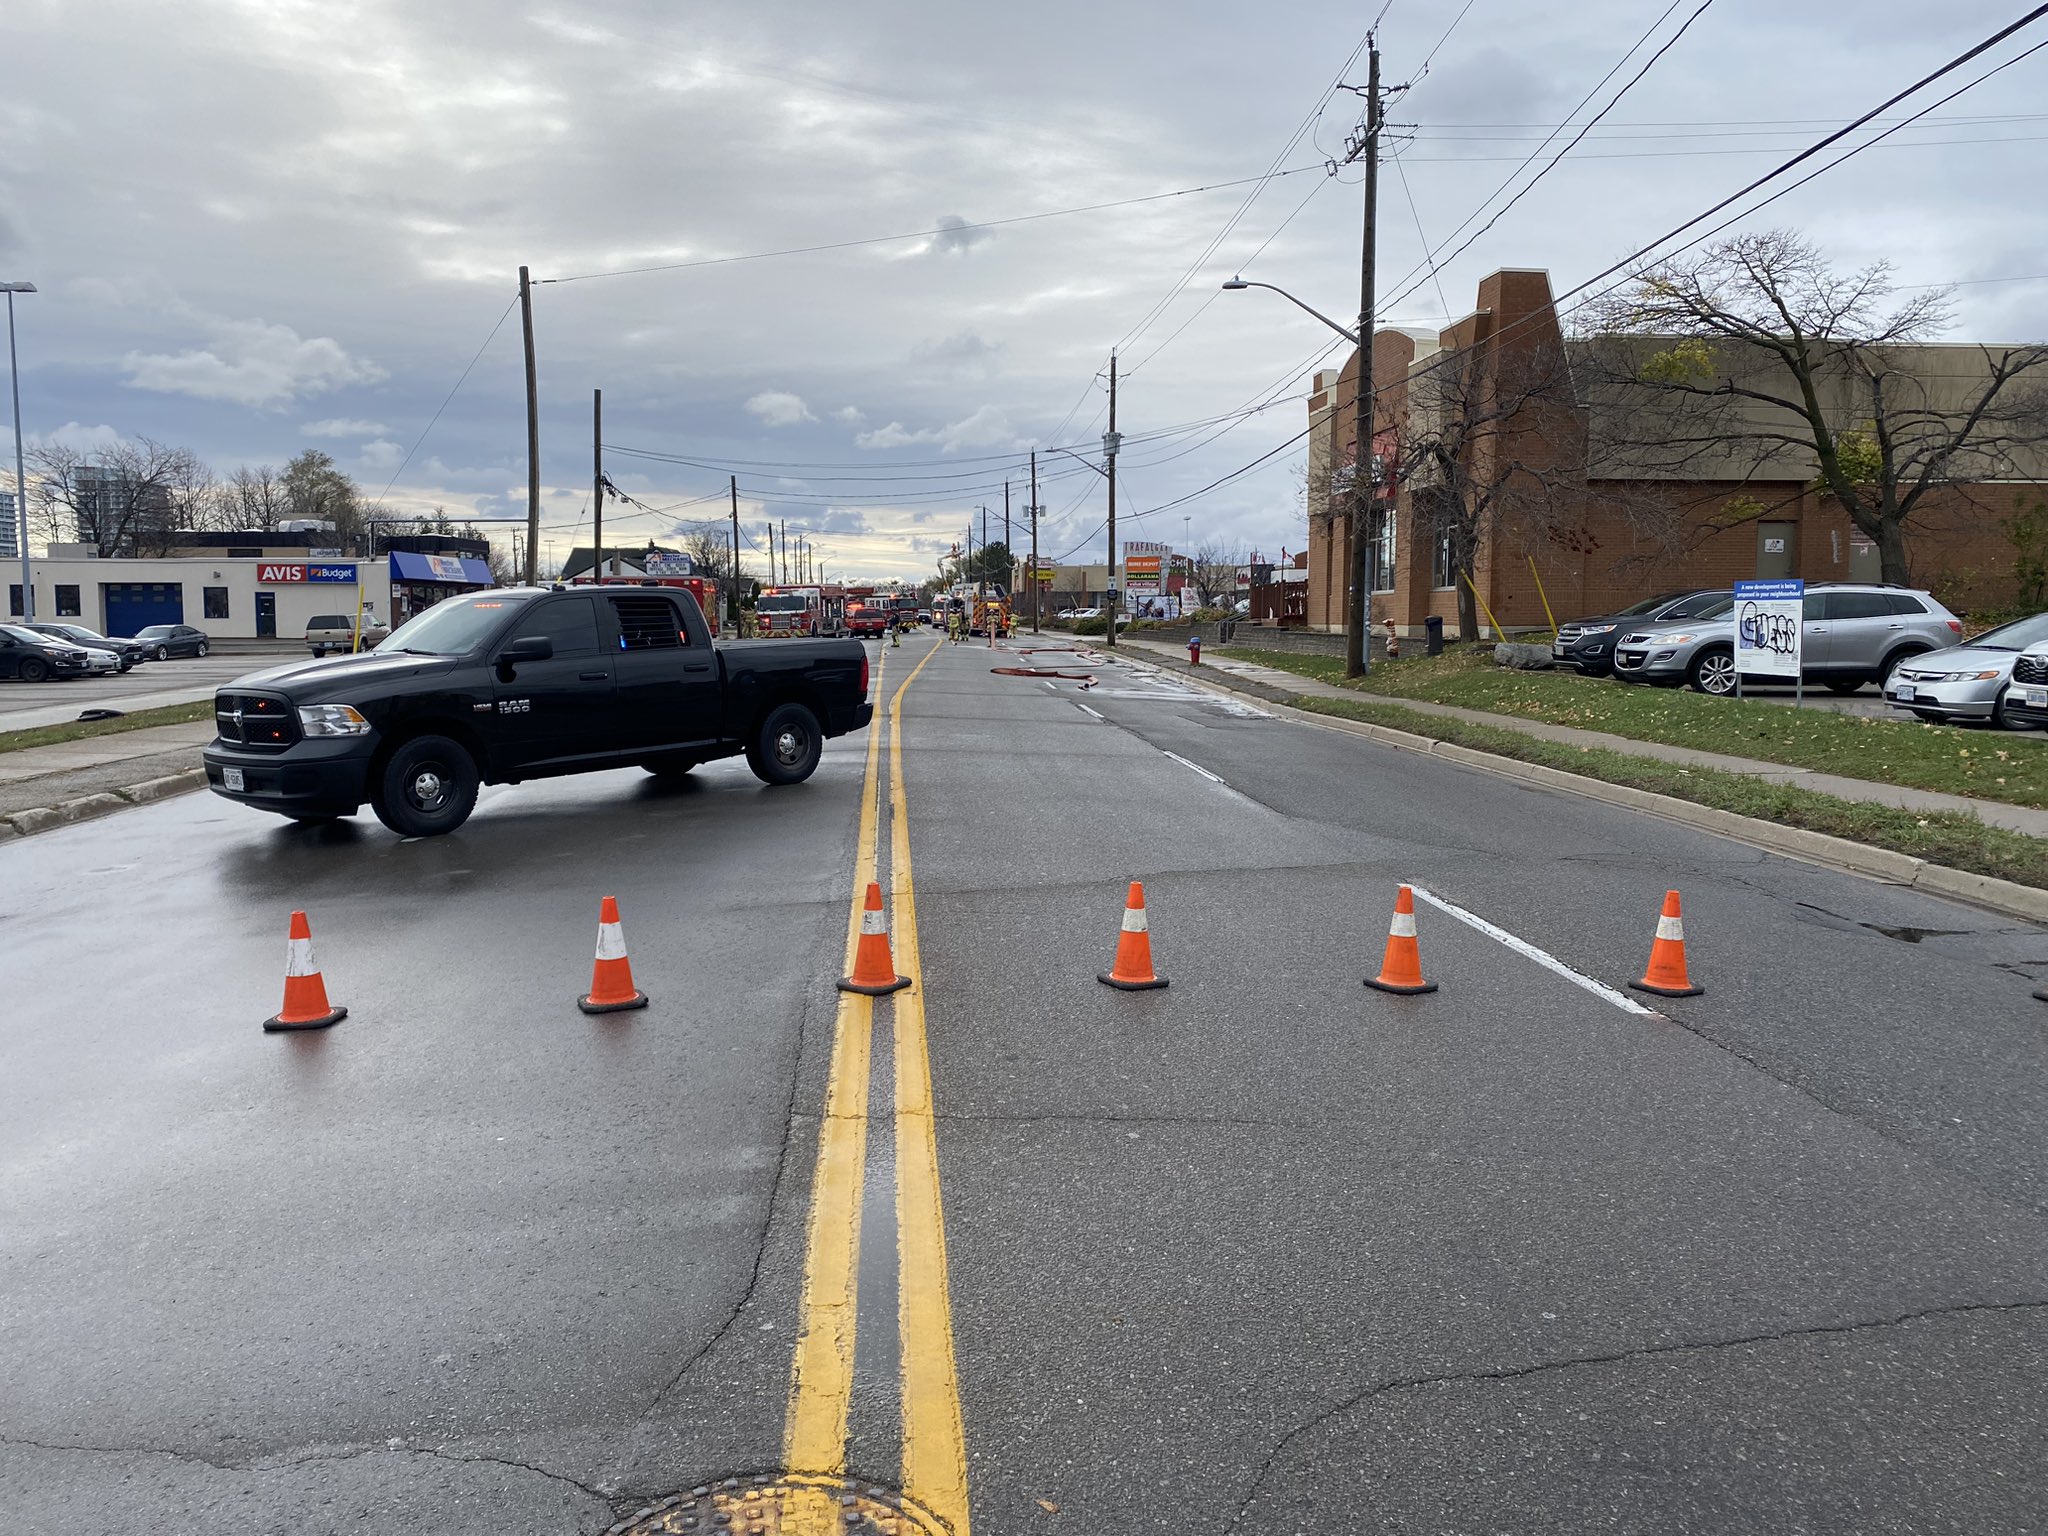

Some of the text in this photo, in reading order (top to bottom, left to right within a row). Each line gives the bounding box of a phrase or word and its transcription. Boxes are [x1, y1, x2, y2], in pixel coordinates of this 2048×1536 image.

[262, 566, 302, 580] AVIS
[321, 568, 352, 580] Budget
[498, 705, 530, 714] 1500
